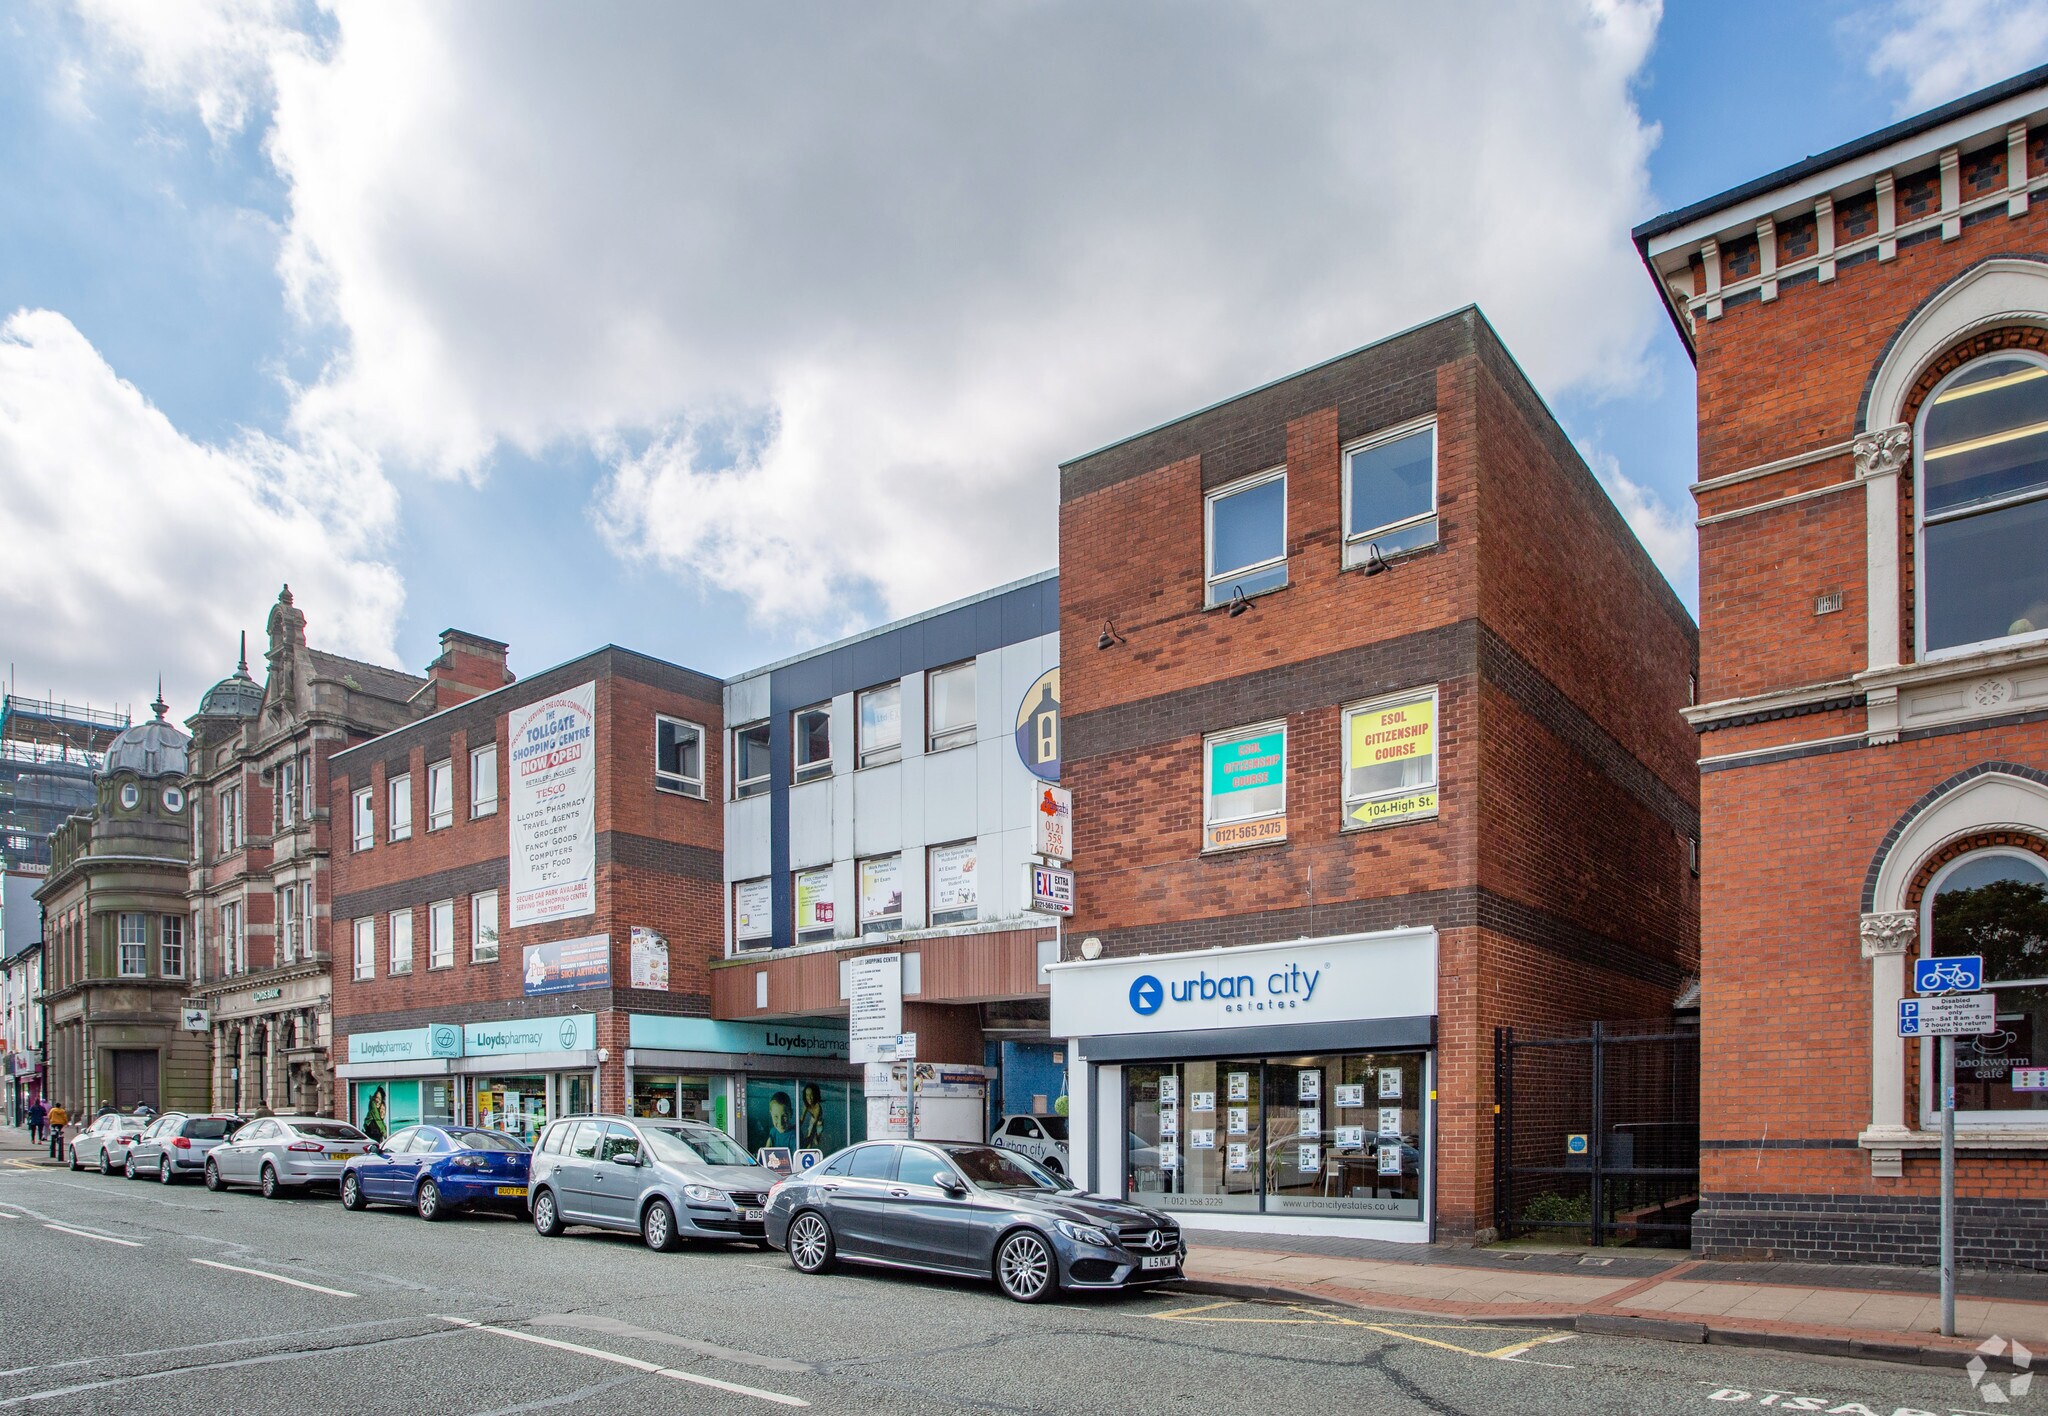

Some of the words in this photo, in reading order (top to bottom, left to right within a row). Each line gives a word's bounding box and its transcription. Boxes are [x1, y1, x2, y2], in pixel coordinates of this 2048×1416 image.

[546, 710, 555, 720] THE
[1381, 711, 1407, 726] ESOL
[511, 721, 528, 748] PROUDLY
[528, 705, 545, 724] SERVING
[546, 702, 554, 710] THE
[567, 700, 592, 721] COMMUNITY
[526, 714, 575, 743] TOLLGATE
[1365, 723, 1429, 746] CITIZENSHIP
[513, 738, 556, 761] SHOPPING
[559, 726, 590, 746] CENTRE
[1238, 742, 1262, 756] ESOL
[1375, 742, 1416, 761] COURSE
[522, 755, 548, 775] NOW
[551, 744, 580, 765] OPEN
[1224, 754, 1281, 774] CITIZENSHIP
[526, 774, 551, 786] RETAILERS
[1232, 772, 1269, 788] COURSE
[536, 783, 566, 799] TESCO
[517, 809, 543, 822] LLOYDS
[546, 797, 586, 814] PHARMACY
[1043, 797, 1069, 815] Punjabi
[1367, 800, 1415, 817] 104-High
[1418, 797, 1434, 807] St.
[522, 820, 548, 831] TRAVEL
[552, 811, 580, 823] AGENTS
[1045, 820, 1064, 835] 0121
[534, 825, 568, 839] GROCERY
[1048, 832, 1062, 845] 558
[1215, 825, 1257, 843] 0121-565
[1259, 821, 1281, 836] 2475
[525, 841, 549, 852] FANCY
[552, 834, 578, 845] GOODS
[1045, 843, 1064, 855] 1767
[529, 846, 573, 861] COMPUTERS
[531, 862, 549, 872] FAST
[552, 857, 571, 868] FOOD
[1036, 871, 1054, 897] EXL
[1054, 875, 1069, 887] EXTRA
[516, 894, 535, 903] SECURE
[535, 891, 545, 899] CAR
[545, 888, 559, 897] PARK
[560, 882, 588, 894] AVAILABLE
[516, 902, 535, 911] SERVING
[545, 895, 570, 906] SHOPPING
[570, 891, 588, 901] CENTRE
[549, 902, 565, 912] TEMPLE
[560, 969, 575, 978] SIKH
[576, 964, 608, 977] ARTIFACTS
[1171, 970, 1254, 1002] urban
[1267, 962, 1320, 1001] city
[1225, 998, 1296, 1013] estates
[361, 1040, 413, 1056] Lloydspharmacy
[477, 1031, 543, 1049] Lloydspharmacy
[765, 1032, 850, 1052] Lloydspharmac
[1955, 1057, 2029, 1068] bookworm
[1975, 1068, 2004, 1079] café
[1030, 1142, 1047, 1159] city
[1171, 1197, 1187, 1205] 0121
[1189, 1198, 1203, 1206] 558
[1204, 1198, 1223, 1207] 3229
[1149, 1258, 1159, 1268] L5
